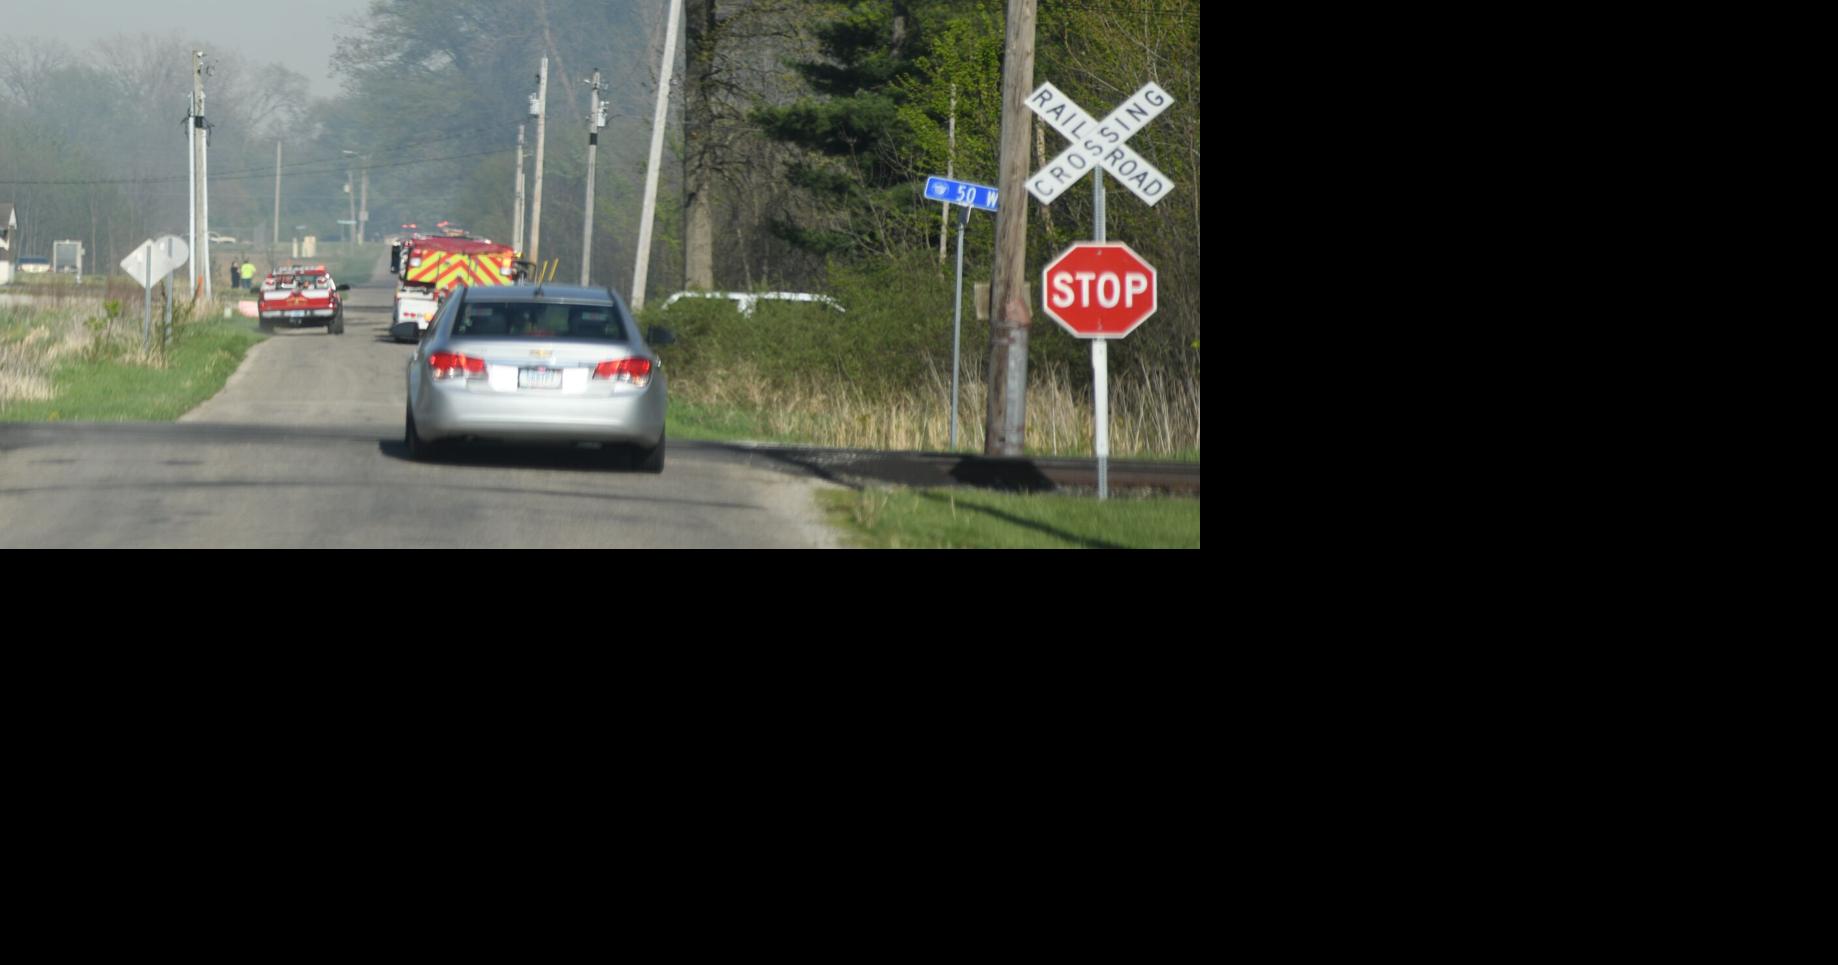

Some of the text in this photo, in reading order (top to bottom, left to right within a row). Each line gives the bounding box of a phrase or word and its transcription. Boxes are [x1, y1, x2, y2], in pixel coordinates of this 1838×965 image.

[1034, 90, 1164, 196] CROSSING
[956, 185, 977, 204] 50
[1052, 271, 1148, 309] STOP
